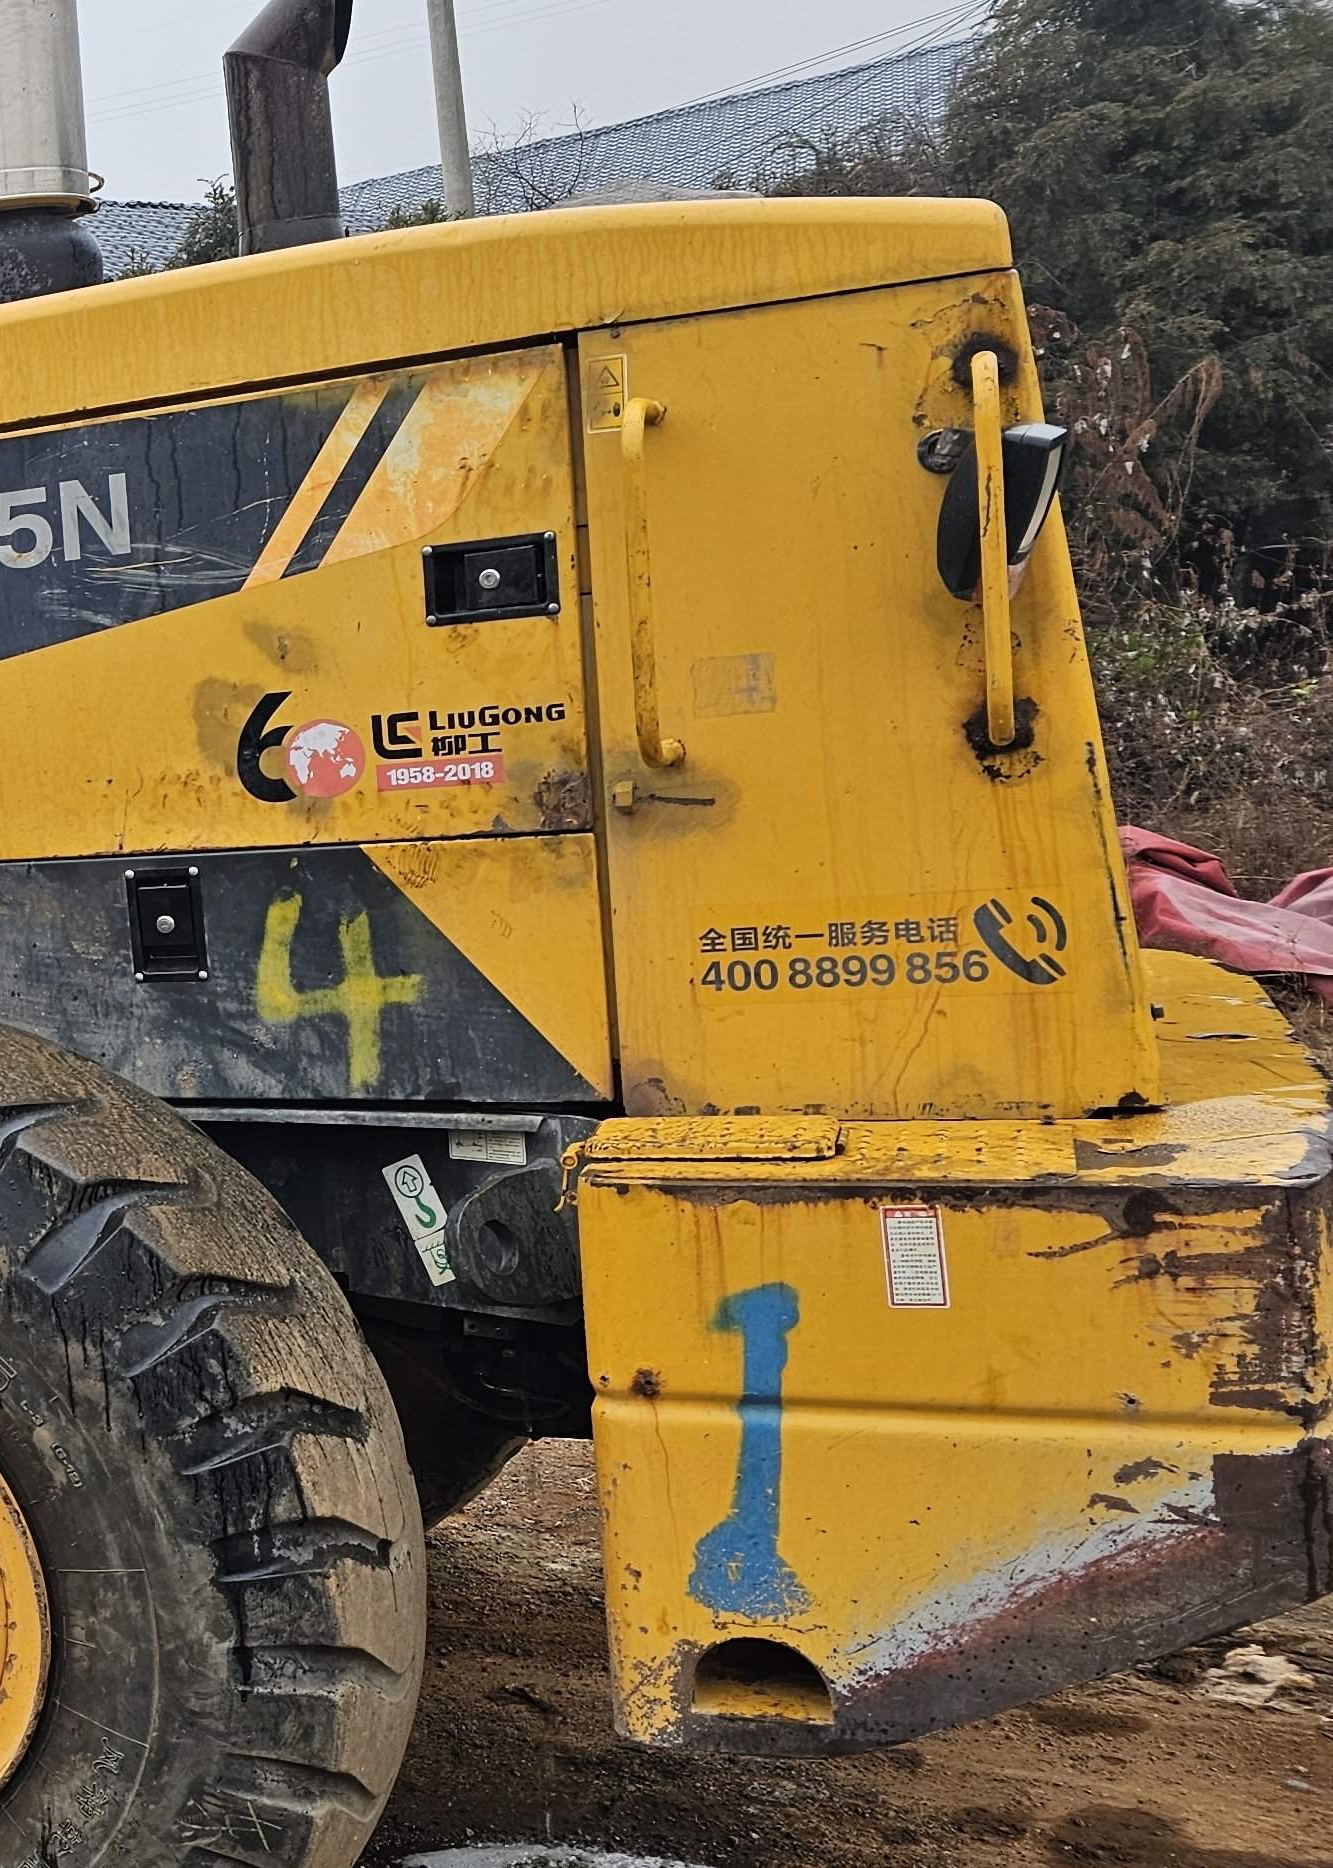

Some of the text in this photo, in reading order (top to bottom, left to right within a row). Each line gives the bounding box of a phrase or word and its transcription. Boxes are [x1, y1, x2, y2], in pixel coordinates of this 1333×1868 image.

[431, 731, 502, 756] 柳工
[386, 761, 494, 786] 1958-2018
[699, 916, 959, 953] 全国统一服务电话
[256, 889, 426, 1089] 4
[700, 949, 990, 992] 400 8899 856
[685, 1281, 812, 1622] 1
